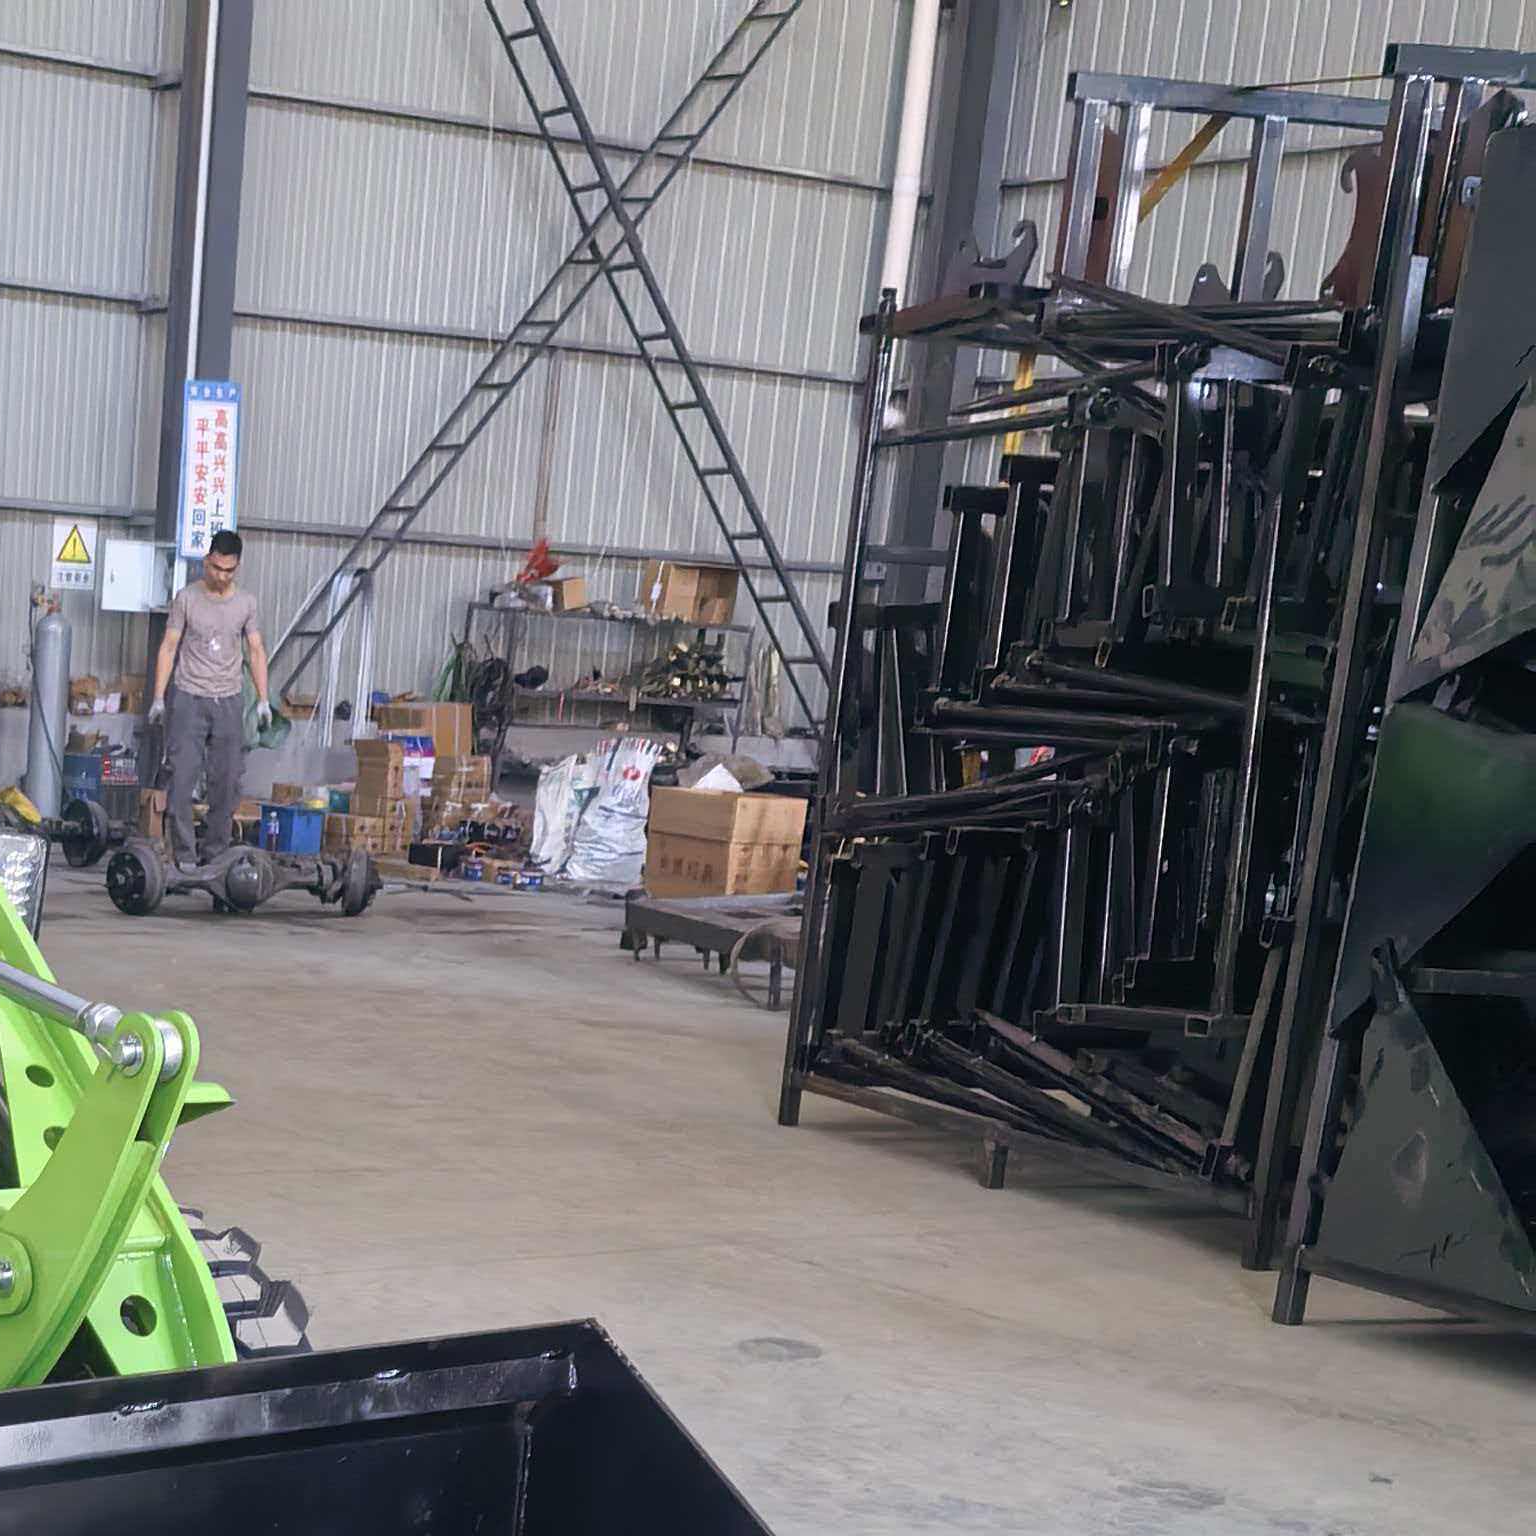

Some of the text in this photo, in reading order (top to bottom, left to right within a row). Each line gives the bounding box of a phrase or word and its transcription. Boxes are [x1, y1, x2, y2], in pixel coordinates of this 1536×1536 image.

[192, 418, 209, 549] 平平安安回家
